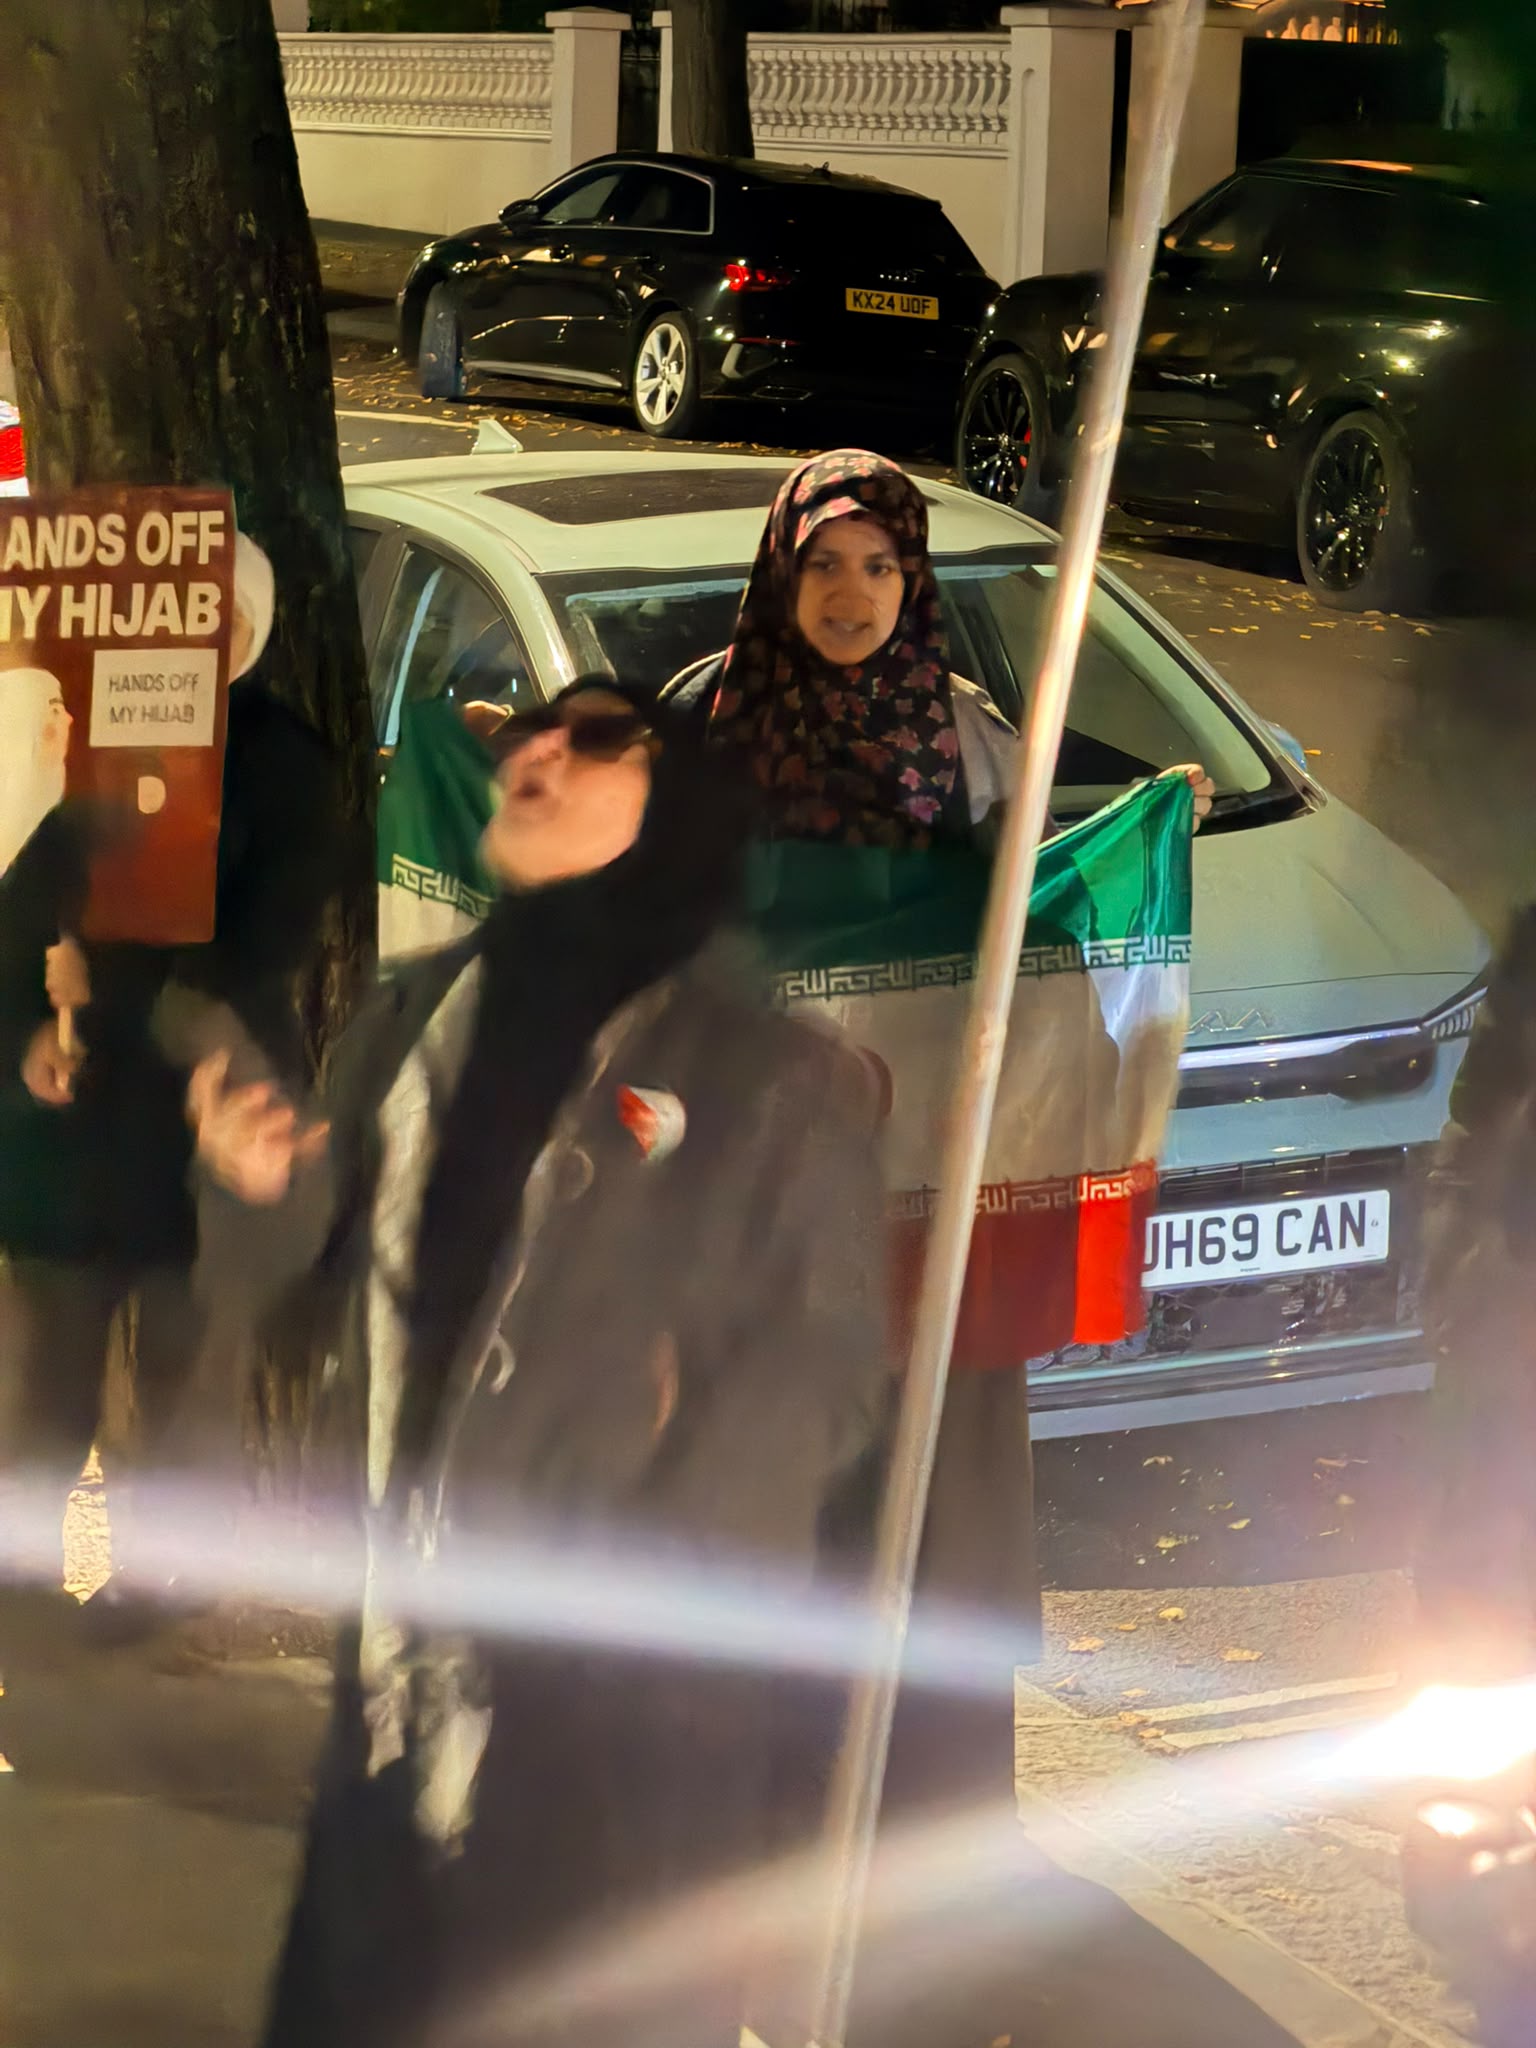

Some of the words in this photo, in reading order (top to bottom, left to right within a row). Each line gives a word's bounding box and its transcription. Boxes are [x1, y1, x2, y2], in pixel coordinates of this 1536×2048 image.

[852, 291, 896, 312] KX24
[0, 512, 127, 572] ANDS
[135, 510, 226, 567] OFF
[59, 581, 222, 639] HIJAB
[108, 673, 165, 693] HANDS
[169, 672, 200, 693] OFF
[110, 704, 137, 724] MY
[141, 704, 195, 724] HIJAB
[1276, 1199, 1367, 1257] CAN
